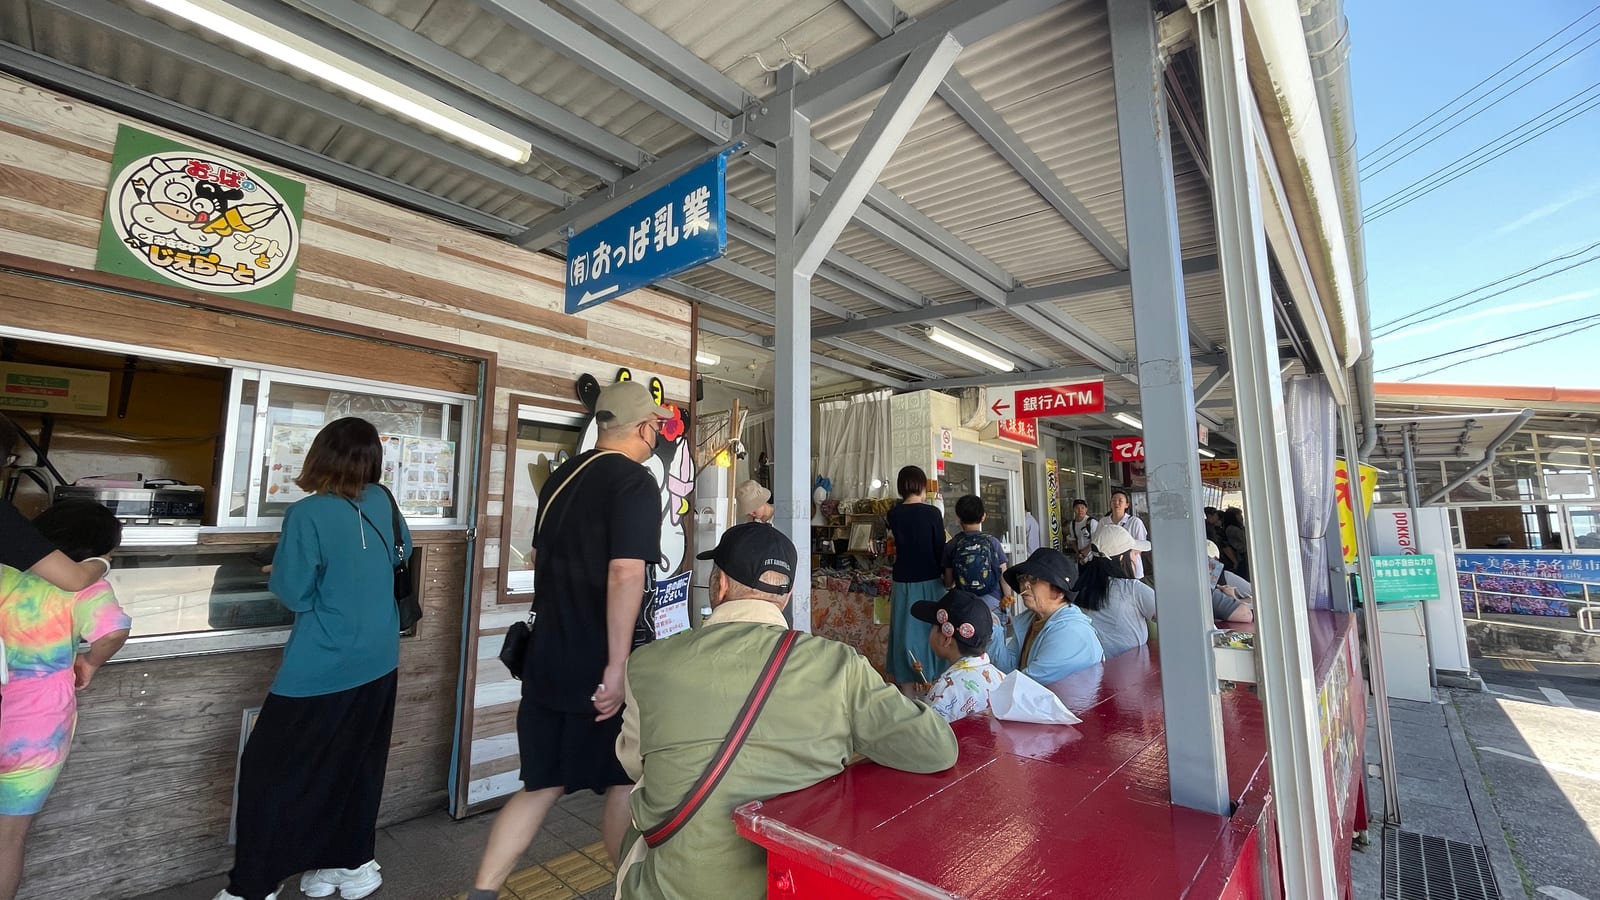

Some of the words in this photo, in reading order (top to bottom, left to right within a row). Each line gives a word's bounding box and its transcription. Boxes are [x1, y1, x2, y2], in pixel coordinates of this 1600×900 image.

[233, 234, 284, 259] ソフト
[1023, 390, 1093, 411] 銀行ATM
